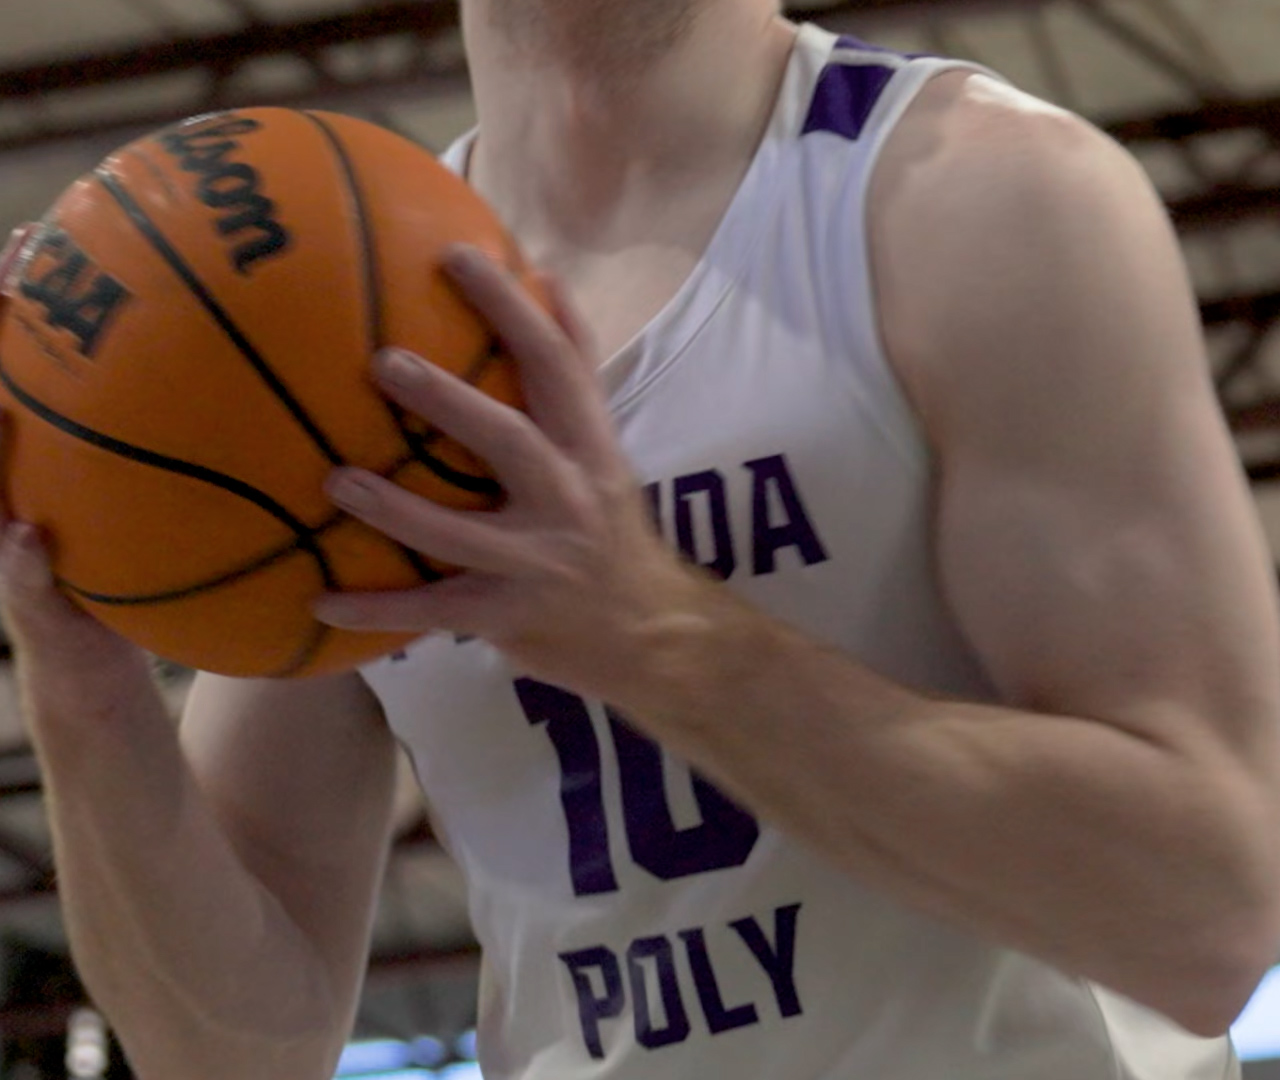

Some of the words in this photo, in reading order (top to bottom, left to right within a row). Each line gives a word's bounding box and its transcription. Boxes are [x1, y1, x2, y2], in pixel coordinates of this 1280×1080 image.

[164, 116, 287, 274] lson
[513, 676, 760, 897] 10
[558, 903, 803, 1059] POLY
